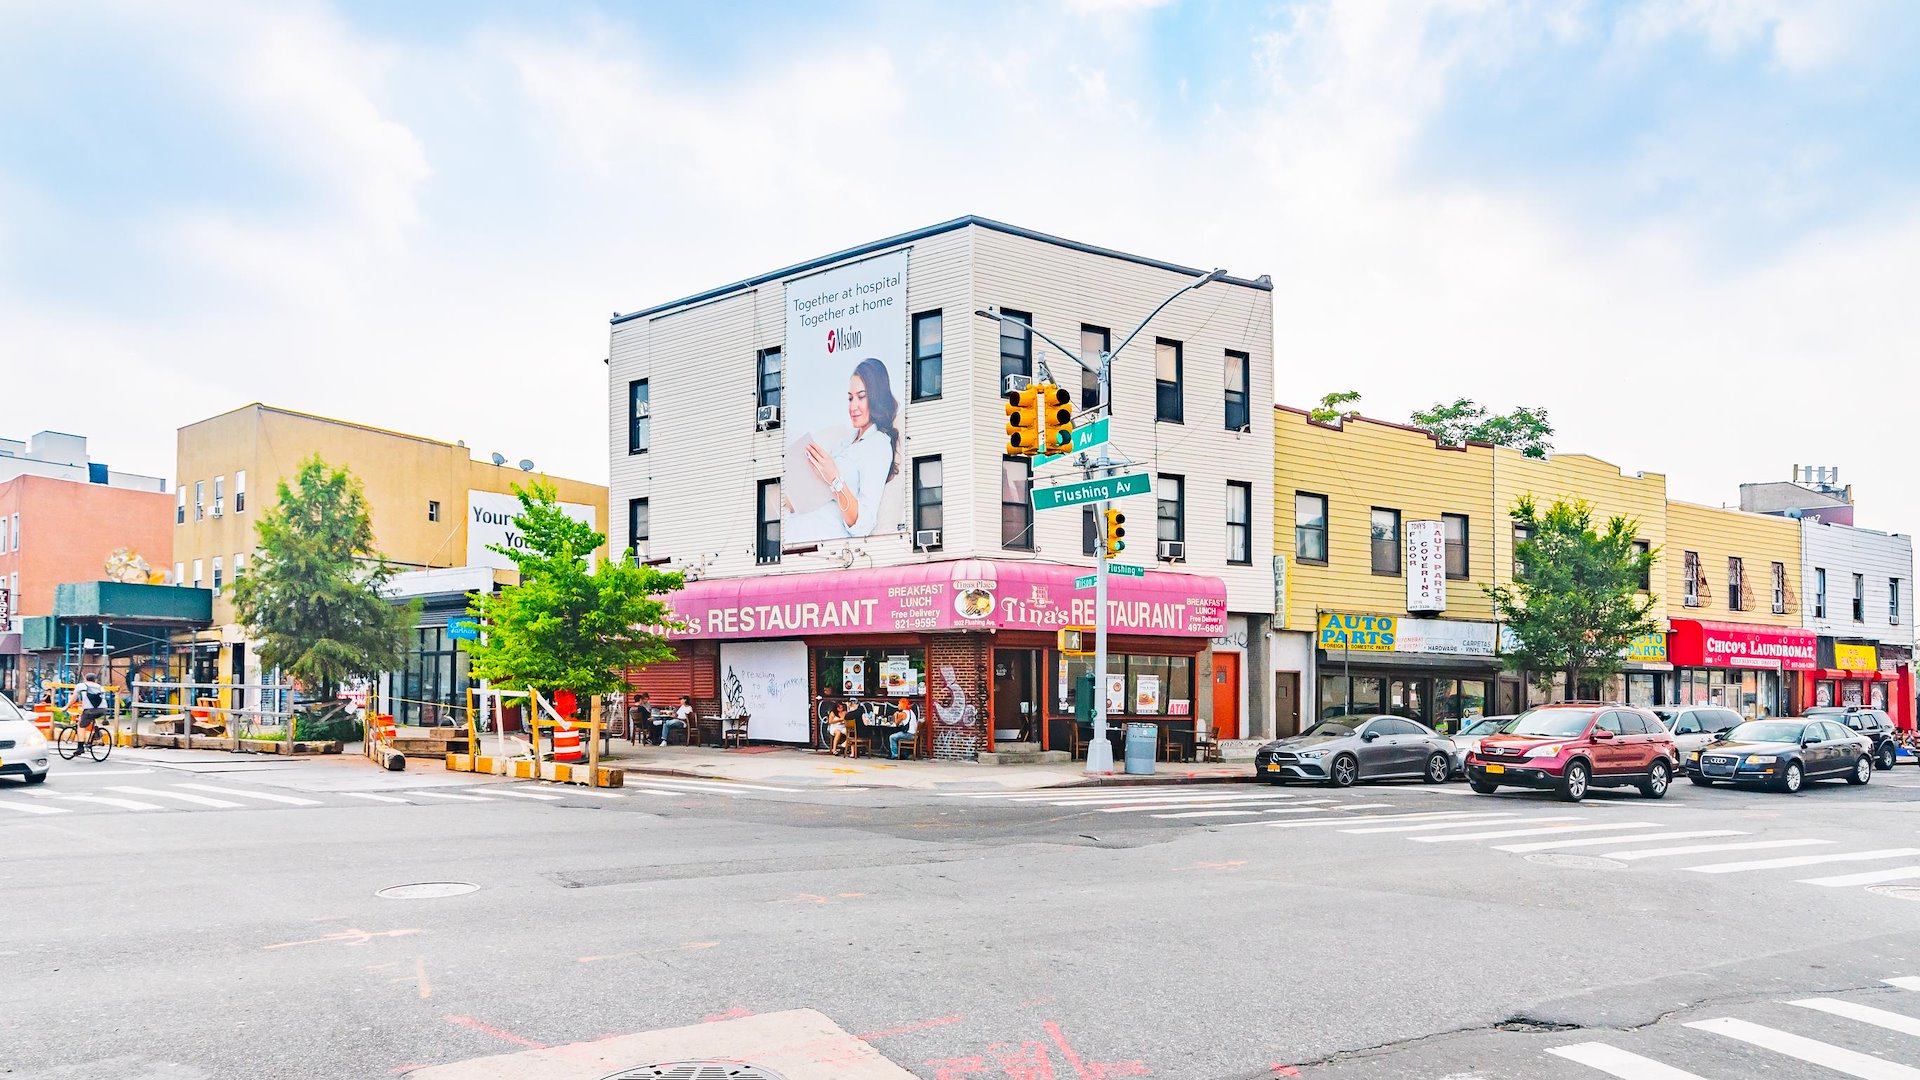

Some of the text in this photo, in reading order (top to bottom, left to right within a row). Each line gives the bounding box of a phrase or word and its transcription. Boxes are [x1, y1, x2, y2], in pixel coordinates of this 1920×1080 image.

[793, 272, 901, 312] Together at hospital
[800, 295, 894, 328] Together at home
[1079, 432, 1093, 446] Av
[1054, 481, 1131, 503] Flushing Av
[473, 506, 511, 526] Your
[1409, 532, 1417, 566] FLOOR
[1434, 530, 1442, 560] AUTO
[1421, 541, 1429, 598] COVERING
[888, 584, 944, 597] BREAKFAST
[1434, 564, 1442, 602] PARTS
[900, 596, 932, 608] LUNCH
[1186, 598, 1225, 607] BREAKFAST
[708, 599, 879, 633] RESTAURANT
[891, 609, 941, 619] Free Delivery
[1001, 597, 1186, 630] Tina's RETAURANT
[1195, 607, 1217, 615] LUNCH
[895, 617, 937, 629] 821-9595
[965, 619, 985, 627] Flushing
[1201, 616, 1222, 624] Delivery
[1325, 615, 1392, 631] AUTO
[1187, 624, 1224, 633] 497-6890
[1321, 629, 1394, 645] PARTS
[1627, 644, 1665, 656] PARTS
[1706, 637, 1814, 658] CHICO'S LAUNDROMAT
[1169, 702, 1189, 715] ATM
